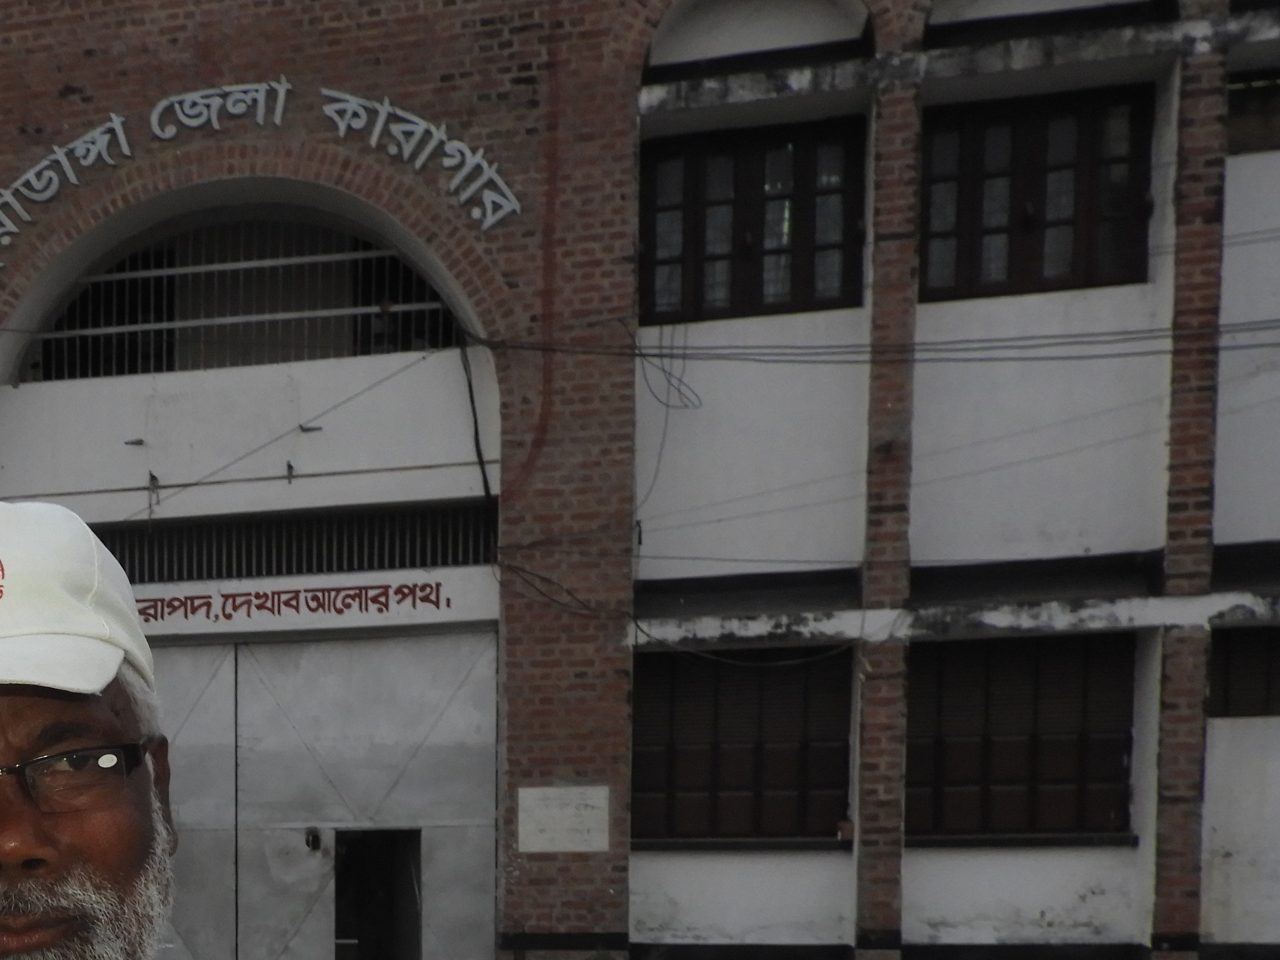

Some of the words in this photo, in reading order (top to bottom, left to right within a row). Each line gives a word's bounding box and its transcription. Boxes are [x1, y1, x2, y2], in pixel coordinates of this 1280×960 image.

[150, 75, 293, 141] জেলা
[320, 87, 520, 230] কারাগার
[137, 595, 220, 624] রাপদ,
[303, 585, 391, 616] আলোর
